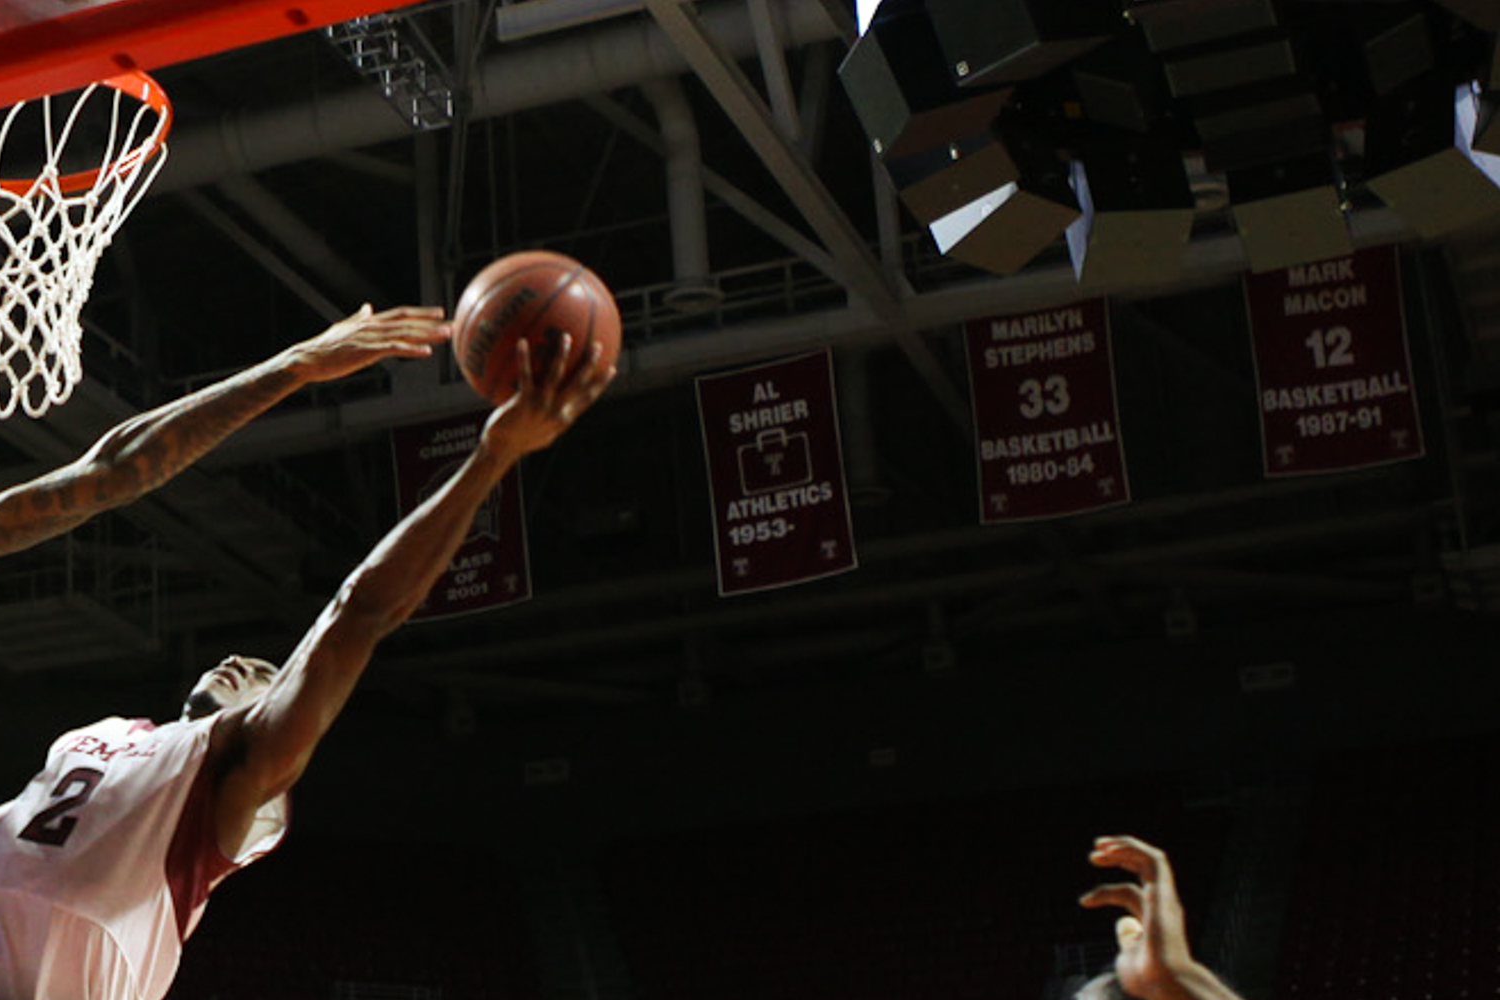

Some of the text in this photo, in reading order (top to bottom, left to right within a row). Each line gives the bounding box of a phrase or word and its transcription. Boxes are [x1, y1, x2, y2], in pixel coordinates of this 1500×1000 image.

[1288, 258, 1355, 287] MARK
[1283, 284, 1368, 316] MACON
[990, 308, 1084, 341] MARILYN
[984, 331, 1096, 369] STEPHENS
[1305, 325, 1355, 370] 12
[753, 380, 780, 404] AL
[1018, 374, 1072, 420] 33
[1263, 369, 1408, 412] BASKETBALL
[728, 398, 810, 435] SHRIER
[1296, 405, 1383, 438] 1987-91
[418, 438, 480, 461] CHANE
[980, 420, 1115, 461] BASKETBALL
[1006, 452, 1095, 486] 1980-84
[726, 481, 834, 521] ATHLETICS
[449, 551, 494, 571] LASS
[16, 767, 105, 847] 2
